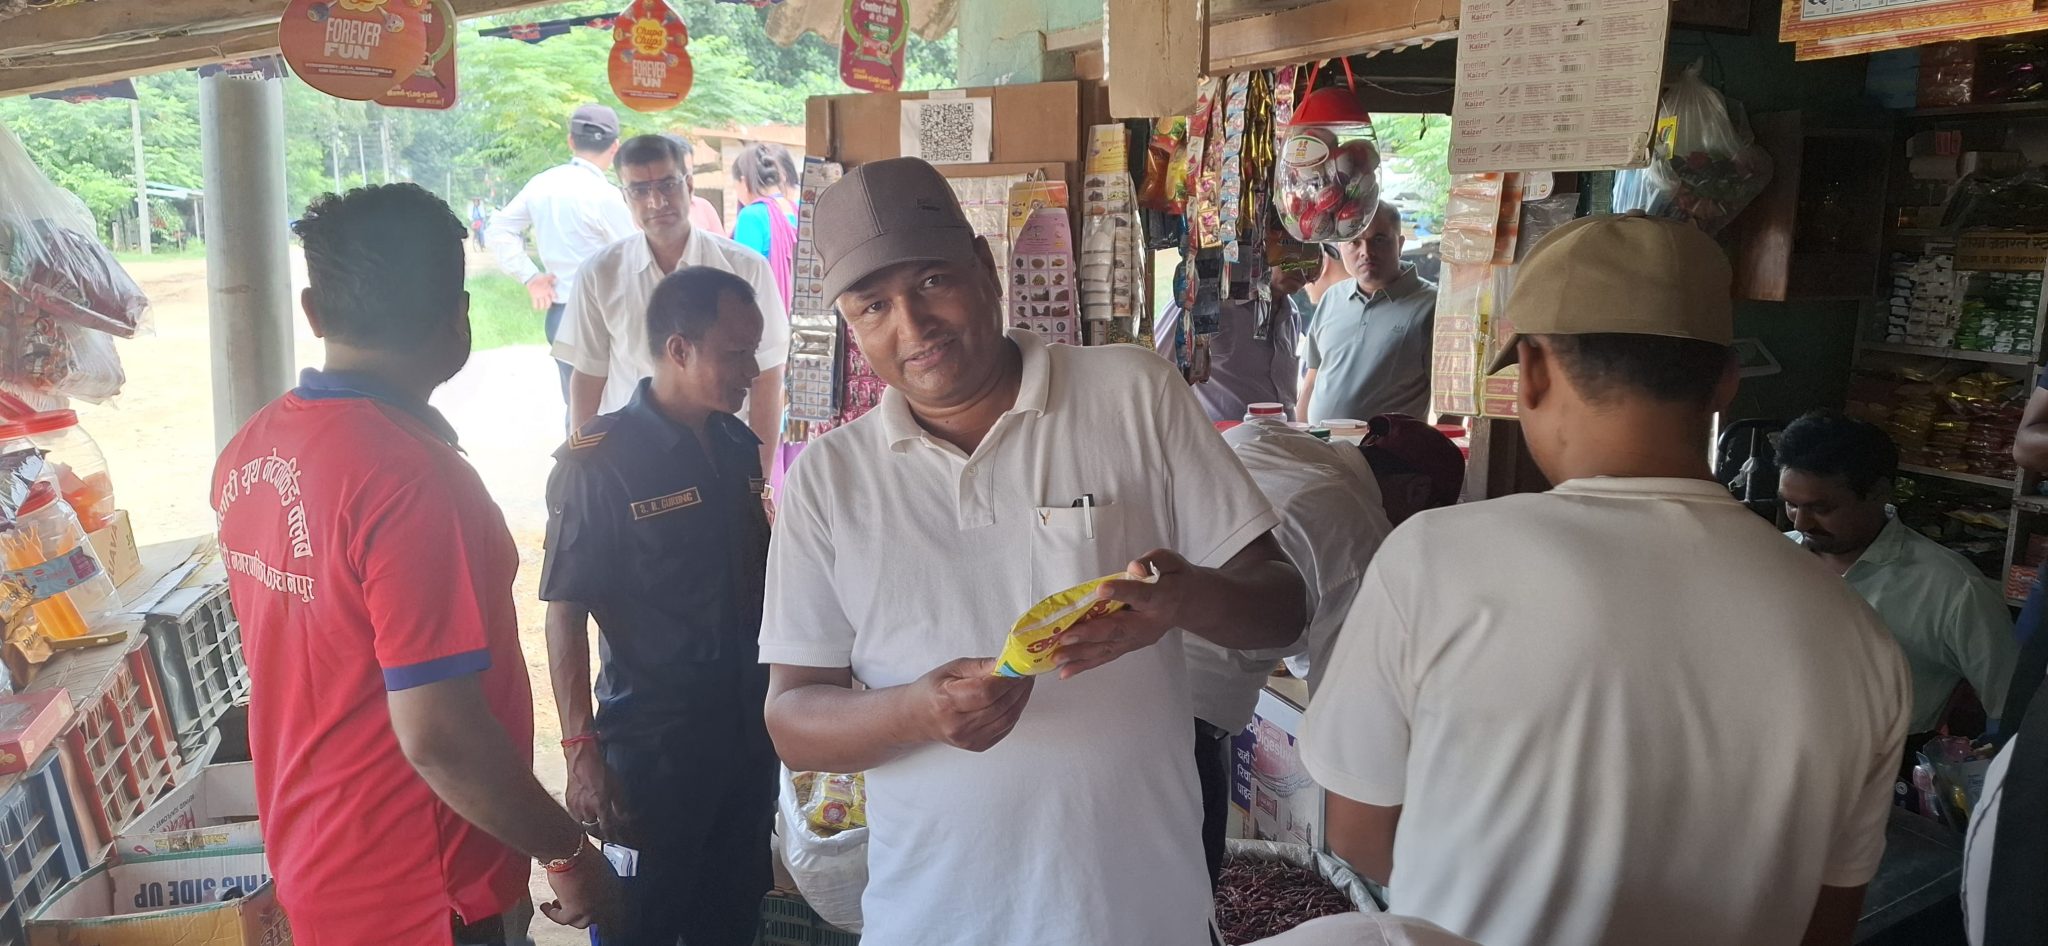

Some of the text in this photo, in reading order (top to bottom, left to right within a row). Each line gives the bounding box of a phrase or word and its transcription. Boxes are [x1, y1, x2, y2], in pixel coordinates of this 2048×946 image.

[1467, 3, 1490, 11] merlin
[1471, 13, 1493, 21] Kaizer
[325, 17, 382, 47] FOREVER
[636, 26, 663, 36] Chupa
[635, 35, 663, 46] Chups
[1465, 32, 1488, 41] merlin
[323, 42, 370, 60] FUN
[632, 59, 667, 78] FOREVER
[1463, 60, 1486, 70] merlin
[1467, 71, 1488, 79] Kaizer
[632, 76, 662, 88] FUN
[1461, 89, 1484, 97] merlin
[1458, 118, 1481, 126] merlin
[1461, 128, 1482, 136] Kaizer
[1455, 146, 1477, 154] merlin
[1457, 156, 1479, 164] Kaizer
[134, 882, 164, 908] UP
